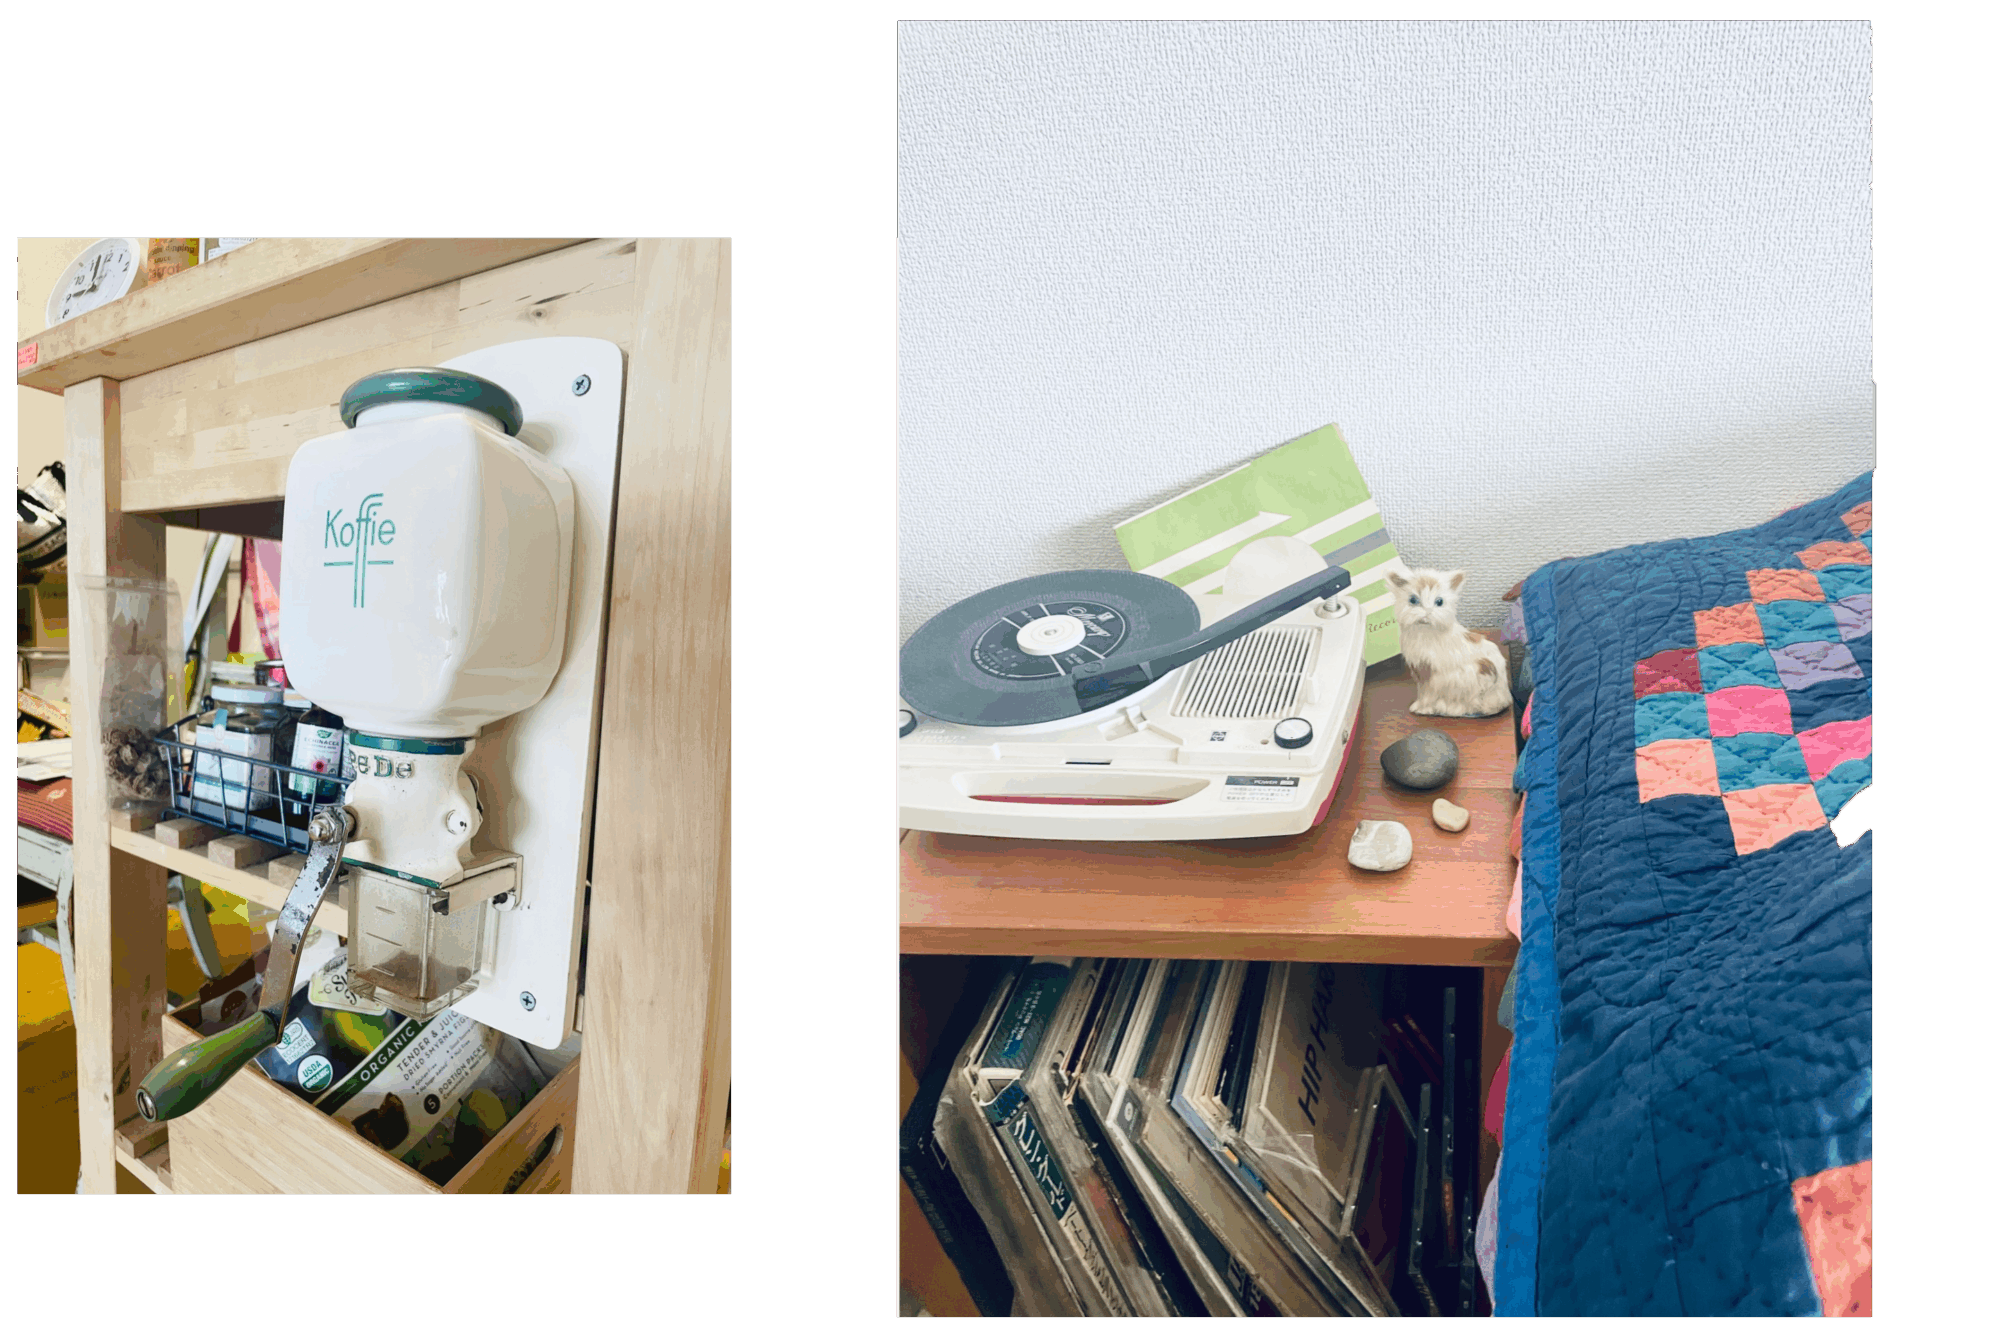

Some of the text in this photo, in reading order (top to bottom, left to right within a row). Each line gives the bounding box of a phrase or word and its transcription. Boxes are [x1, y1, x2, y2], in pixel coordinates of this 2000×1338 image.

[104, 252, 114, 263] 12
[118, 253, 123, 263] 1
[122, 261, 130, 272] 2
[360, 1026, 415, 1081] ORGANIC
[397, 1037, 430, 1072] TENDER
[431, 1029, 438, 1038] &
[440, 1010, 460, 1031] JUIC
[403, 1058, 425, 1081] DRIED
[425, 1030, 453, 1059] SMYRNA
[303, 1061, 322, 1078] USDA
[438, 1063, 466, 1094] PORTION
[1298, 1043, 1323, 1126] HIP
[428, 1098, 436, 1109] 5
[1014, 1110, 1065, 1211] グレン・グールド
